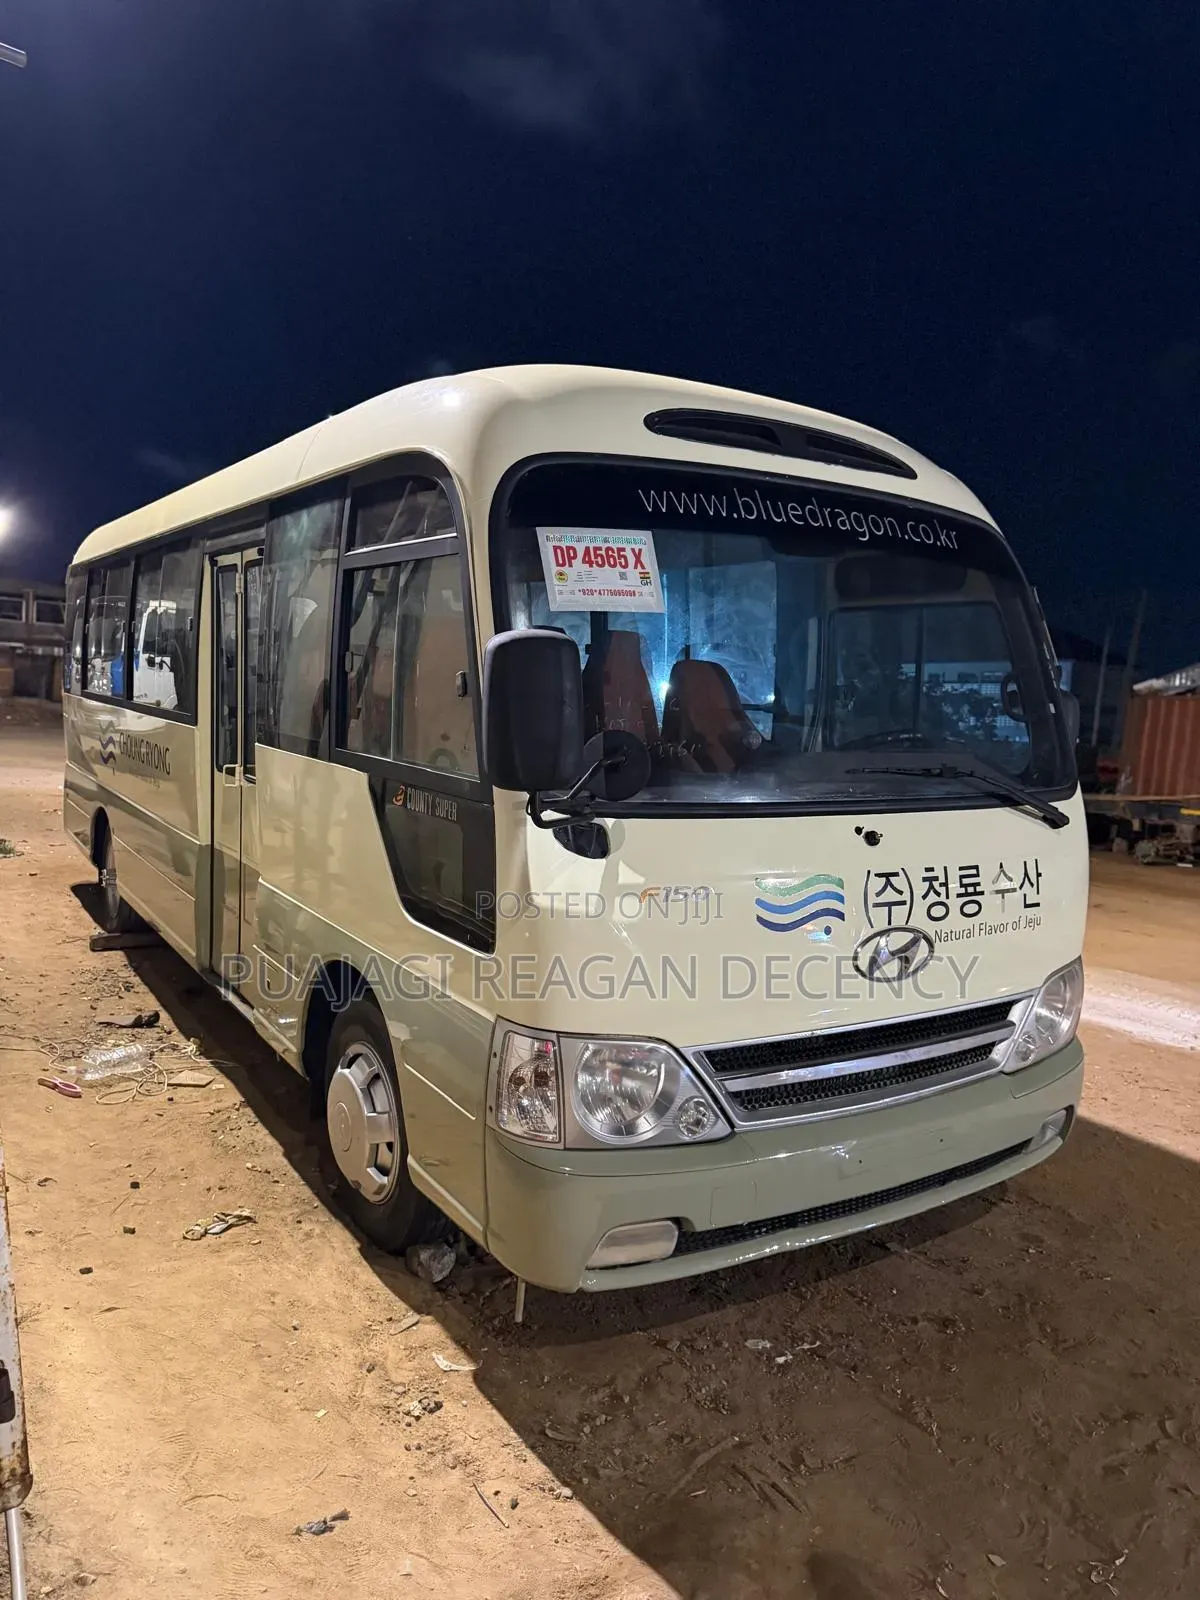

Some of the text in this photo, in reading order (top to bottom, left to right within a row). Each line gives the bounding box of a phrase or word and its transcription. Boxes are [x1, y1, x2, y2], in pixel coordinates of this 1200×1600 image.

[638, 487, 958, 550] www.bluedragon.co.kr
[552, 545, 646, 570] DP 4565 X
[640, 579, 652, 587] GH
[407, 787, 458, 821] COUNTY SUPER
[934, 914, 1042, 944] Natural Flavor of Jeju
